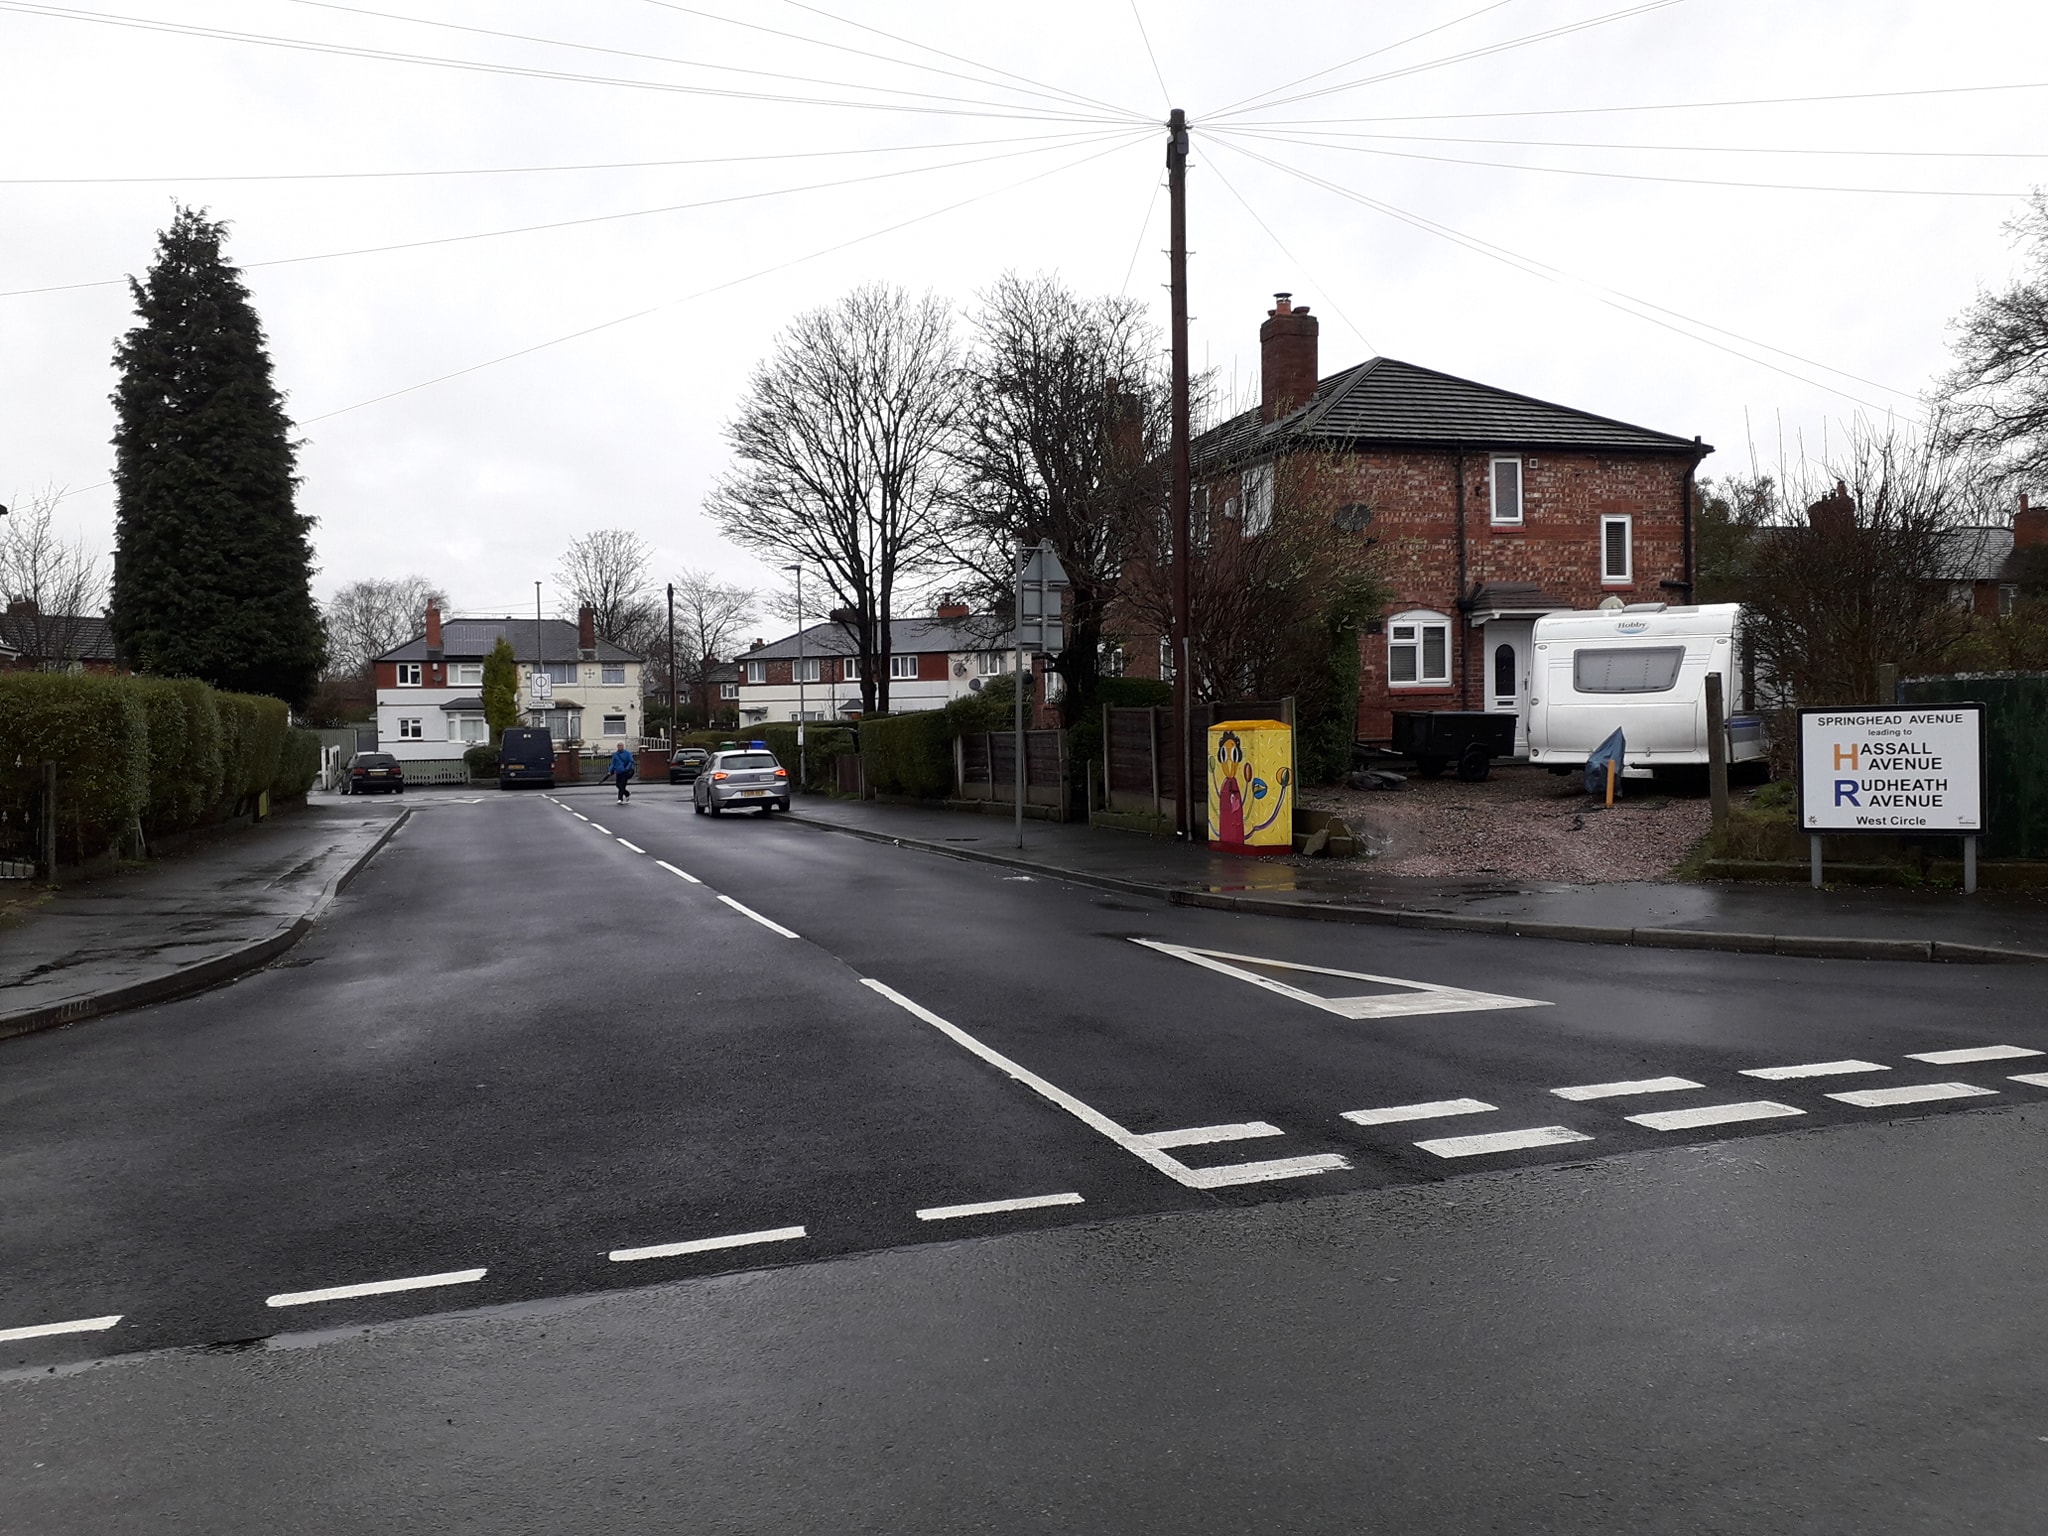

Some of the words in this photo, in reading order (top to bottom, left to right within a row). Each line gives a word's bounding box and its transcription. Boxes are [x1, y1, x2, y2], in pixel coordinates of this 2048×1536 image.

[1617, 621, 1646, 629] Hobby
[1818, 715, 1902, 726] SPRINGHEAD
[1909, 713, 1964, 725] AVENUE
[1868, 729, 1901, 737] leading
[1903, 728, 1913, 736] to
[1833, 742, 1933, 771] HASSALL
[1868, 757, 1943, 770] AVENUE
[1834, 778, 1948, 807] RUDHEATH
[1869, 794, 1944, 807] AVENUE
[1856, 816, 1887, 826] West
[1890, 815, 1927, 826] Circle
